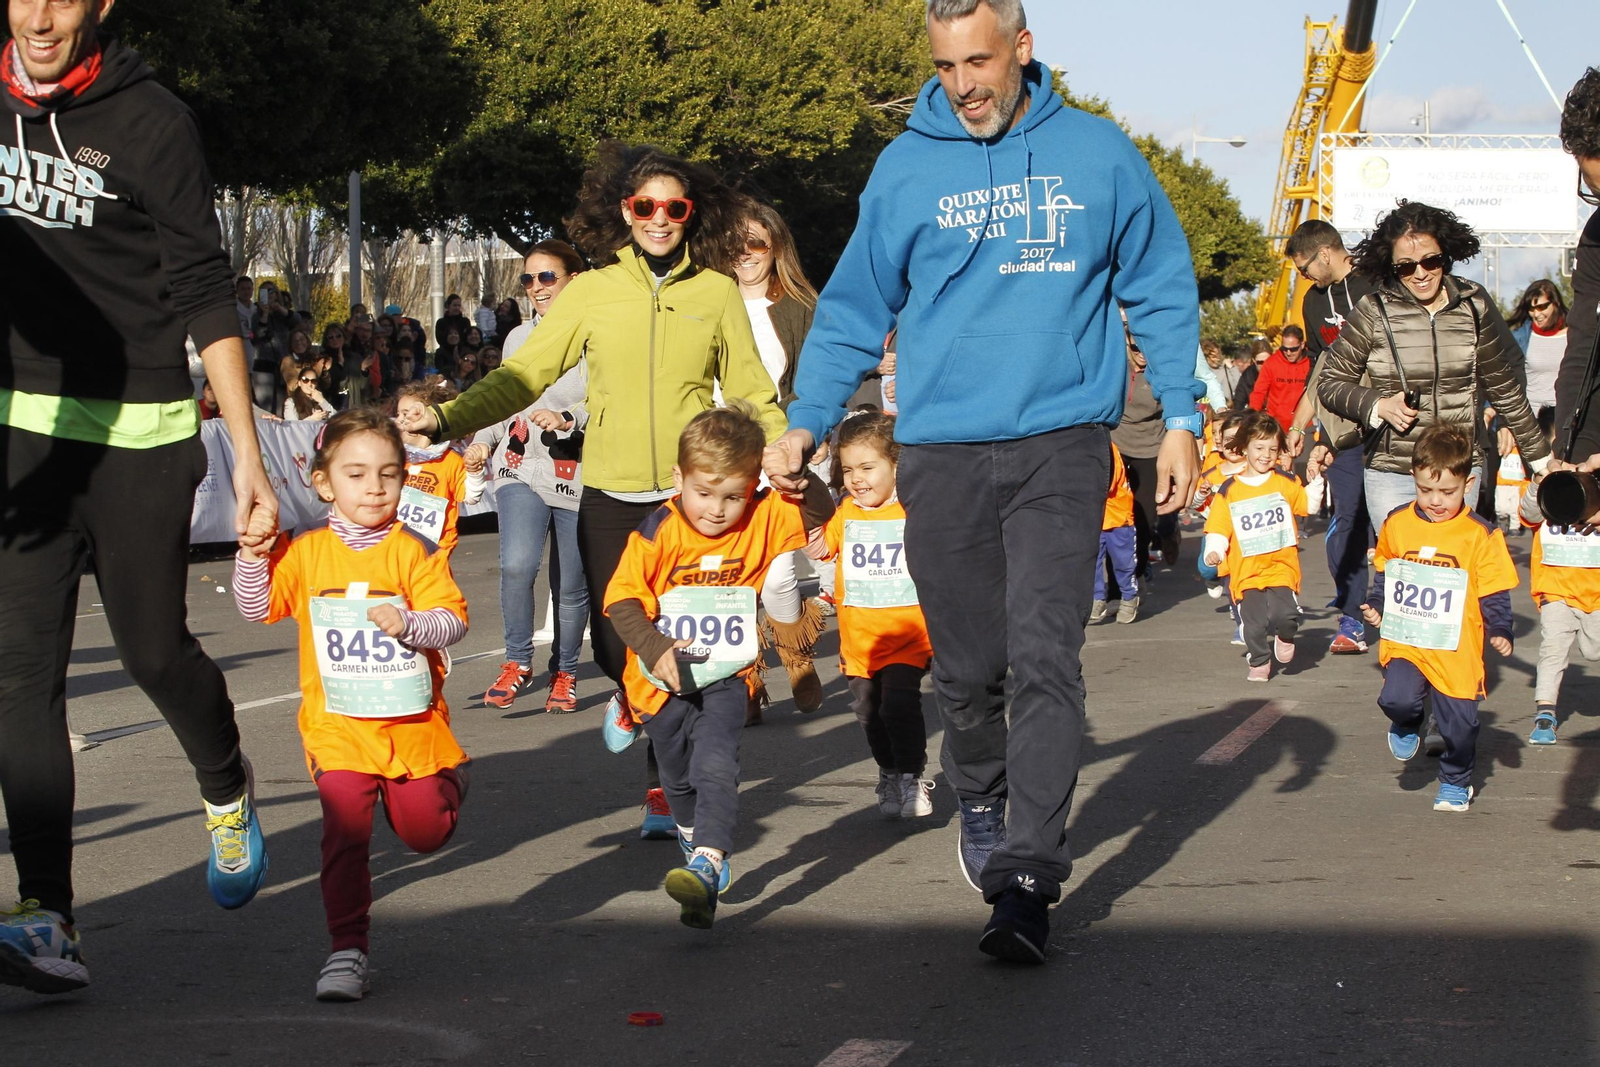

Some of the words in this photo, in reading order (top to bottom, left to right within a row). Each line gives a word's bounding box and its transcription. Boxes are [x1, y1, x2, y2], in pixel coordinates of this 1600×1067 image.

[74, 146, 111, 169] 1990
[938, 184, 1023, 213] QUIXOTE
[935, 200, 1026, 230] MARATÓN
[1019, 247, 1055, 262] 2017
[998, 260, 1045, 275] ciudad
[1048, 259, 1076, 273] real
[1240, 506, 1285, 531] 8228
[681, 567, 741, 586] SUPER
[868, 568, 903, 576] CARLOTA
[1393, 580, 1453, 613] 8201
[1399, 606, 1439, 620] ALEJANDRO
[681, 647, 712, 656] DIEGO
[331, 663, 369, 674] CARMEN
[371, 660, 418, 674] HIDALGO
